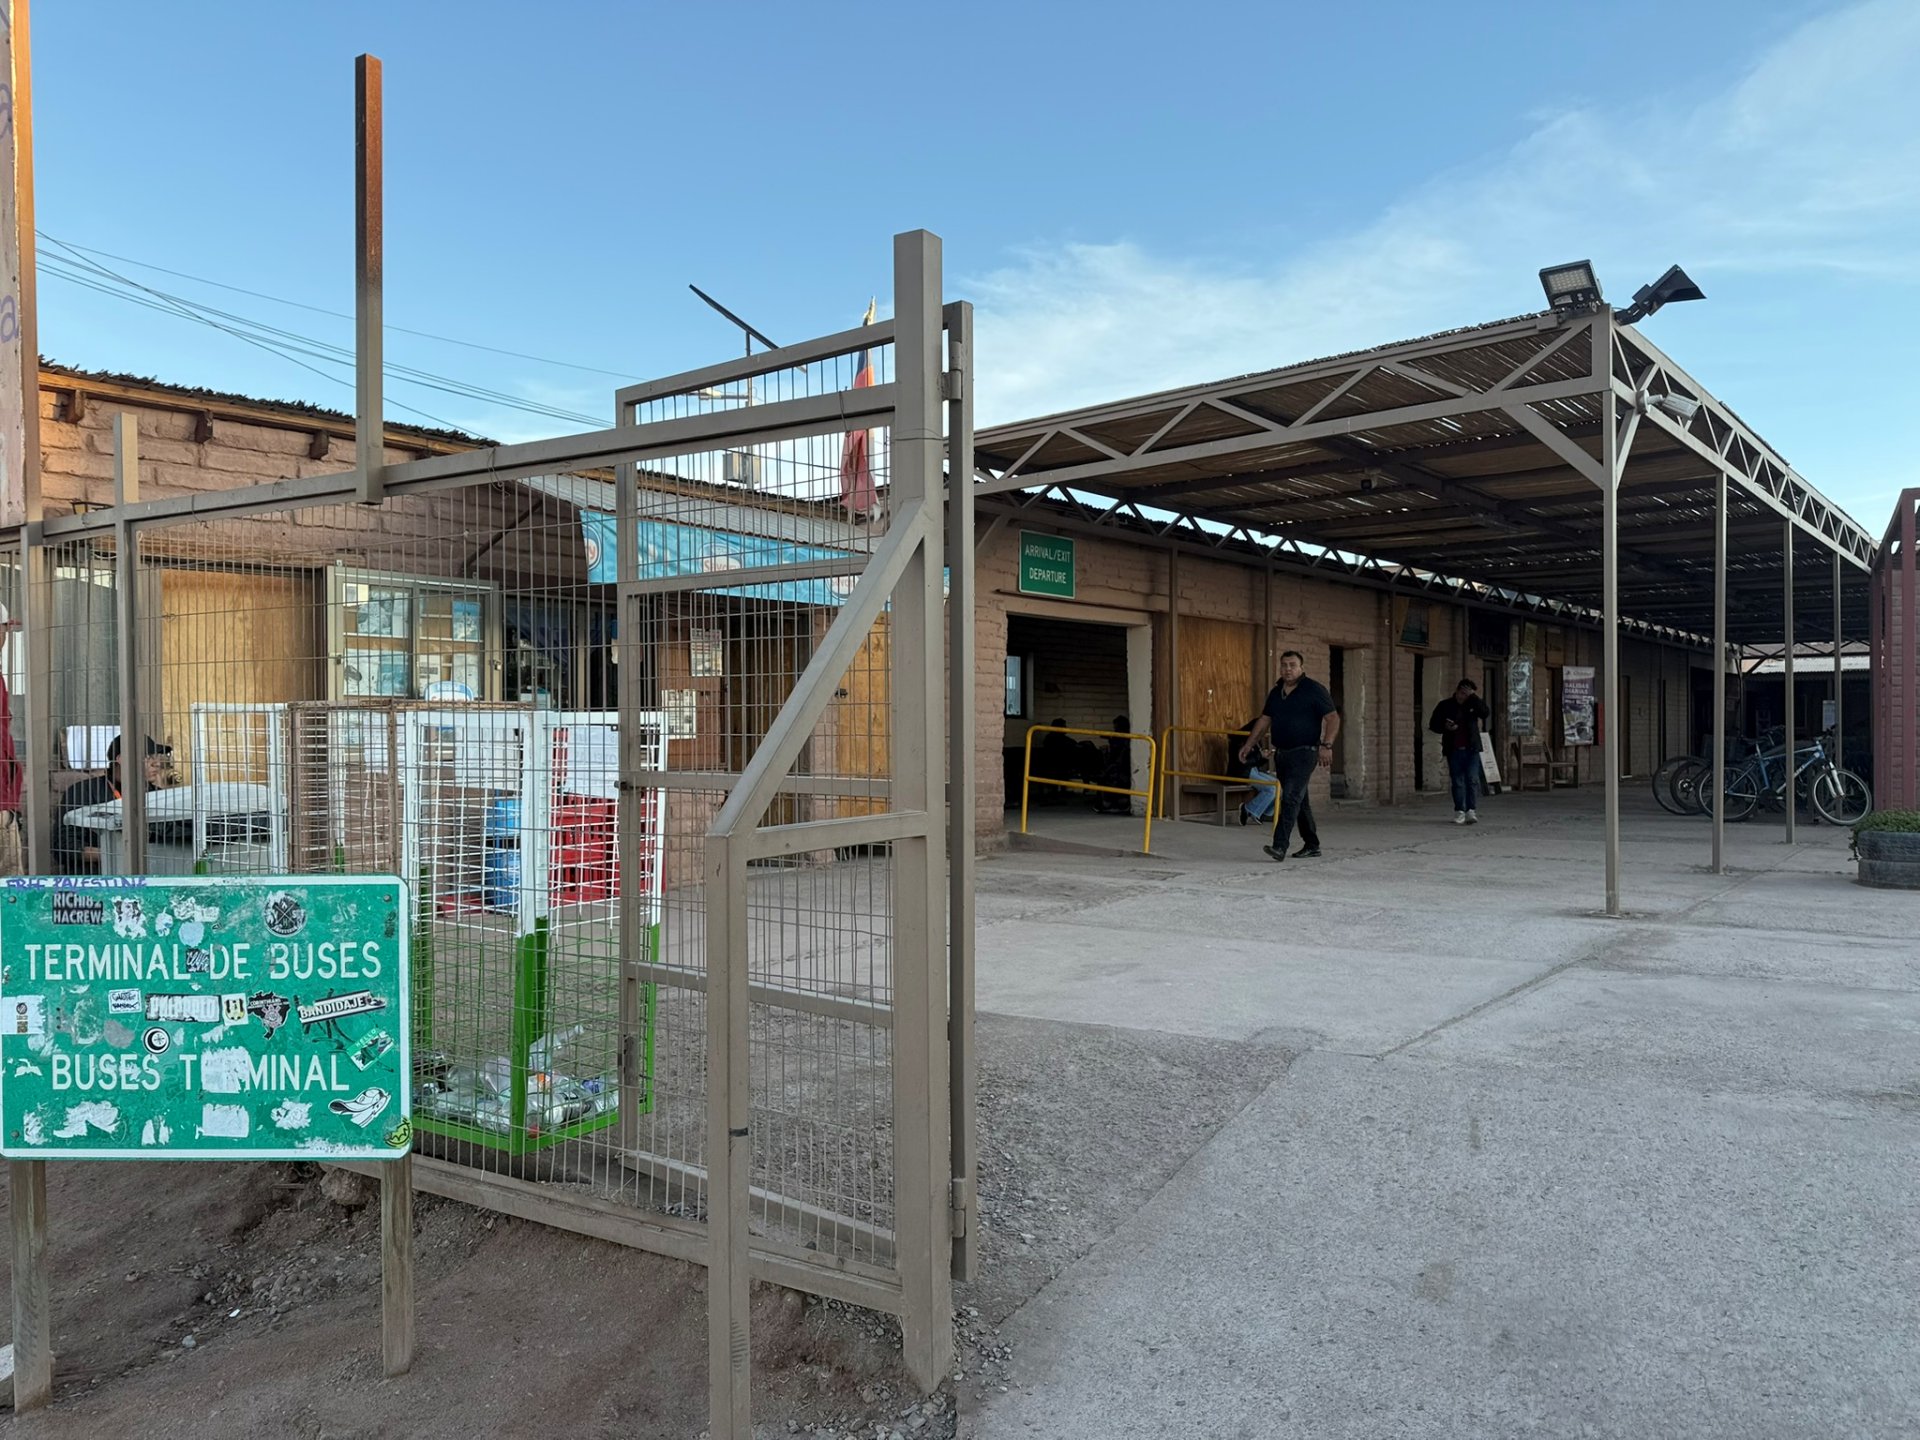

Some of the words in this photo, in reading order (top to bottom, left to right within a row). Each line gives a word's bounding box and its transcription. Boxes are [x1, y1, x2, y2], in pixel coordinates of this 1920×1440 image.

[1025, 544, 1071, 562] ARRIVAL/EXIT
[1029, 567, 1067, 584] DEPARTURE
[53, 877, 148, 890] PALESTINE
[25, 943, 191, 981] TERMINAL
[210, 943, 251, 980] DE
[270, 941, 382, 980] BUSES
[300, 997, 366, 1019] BANDIDAJE
[51, 1053, 161, 1091] BUSES
[179, 1053, 350, 1091] TMINAL
